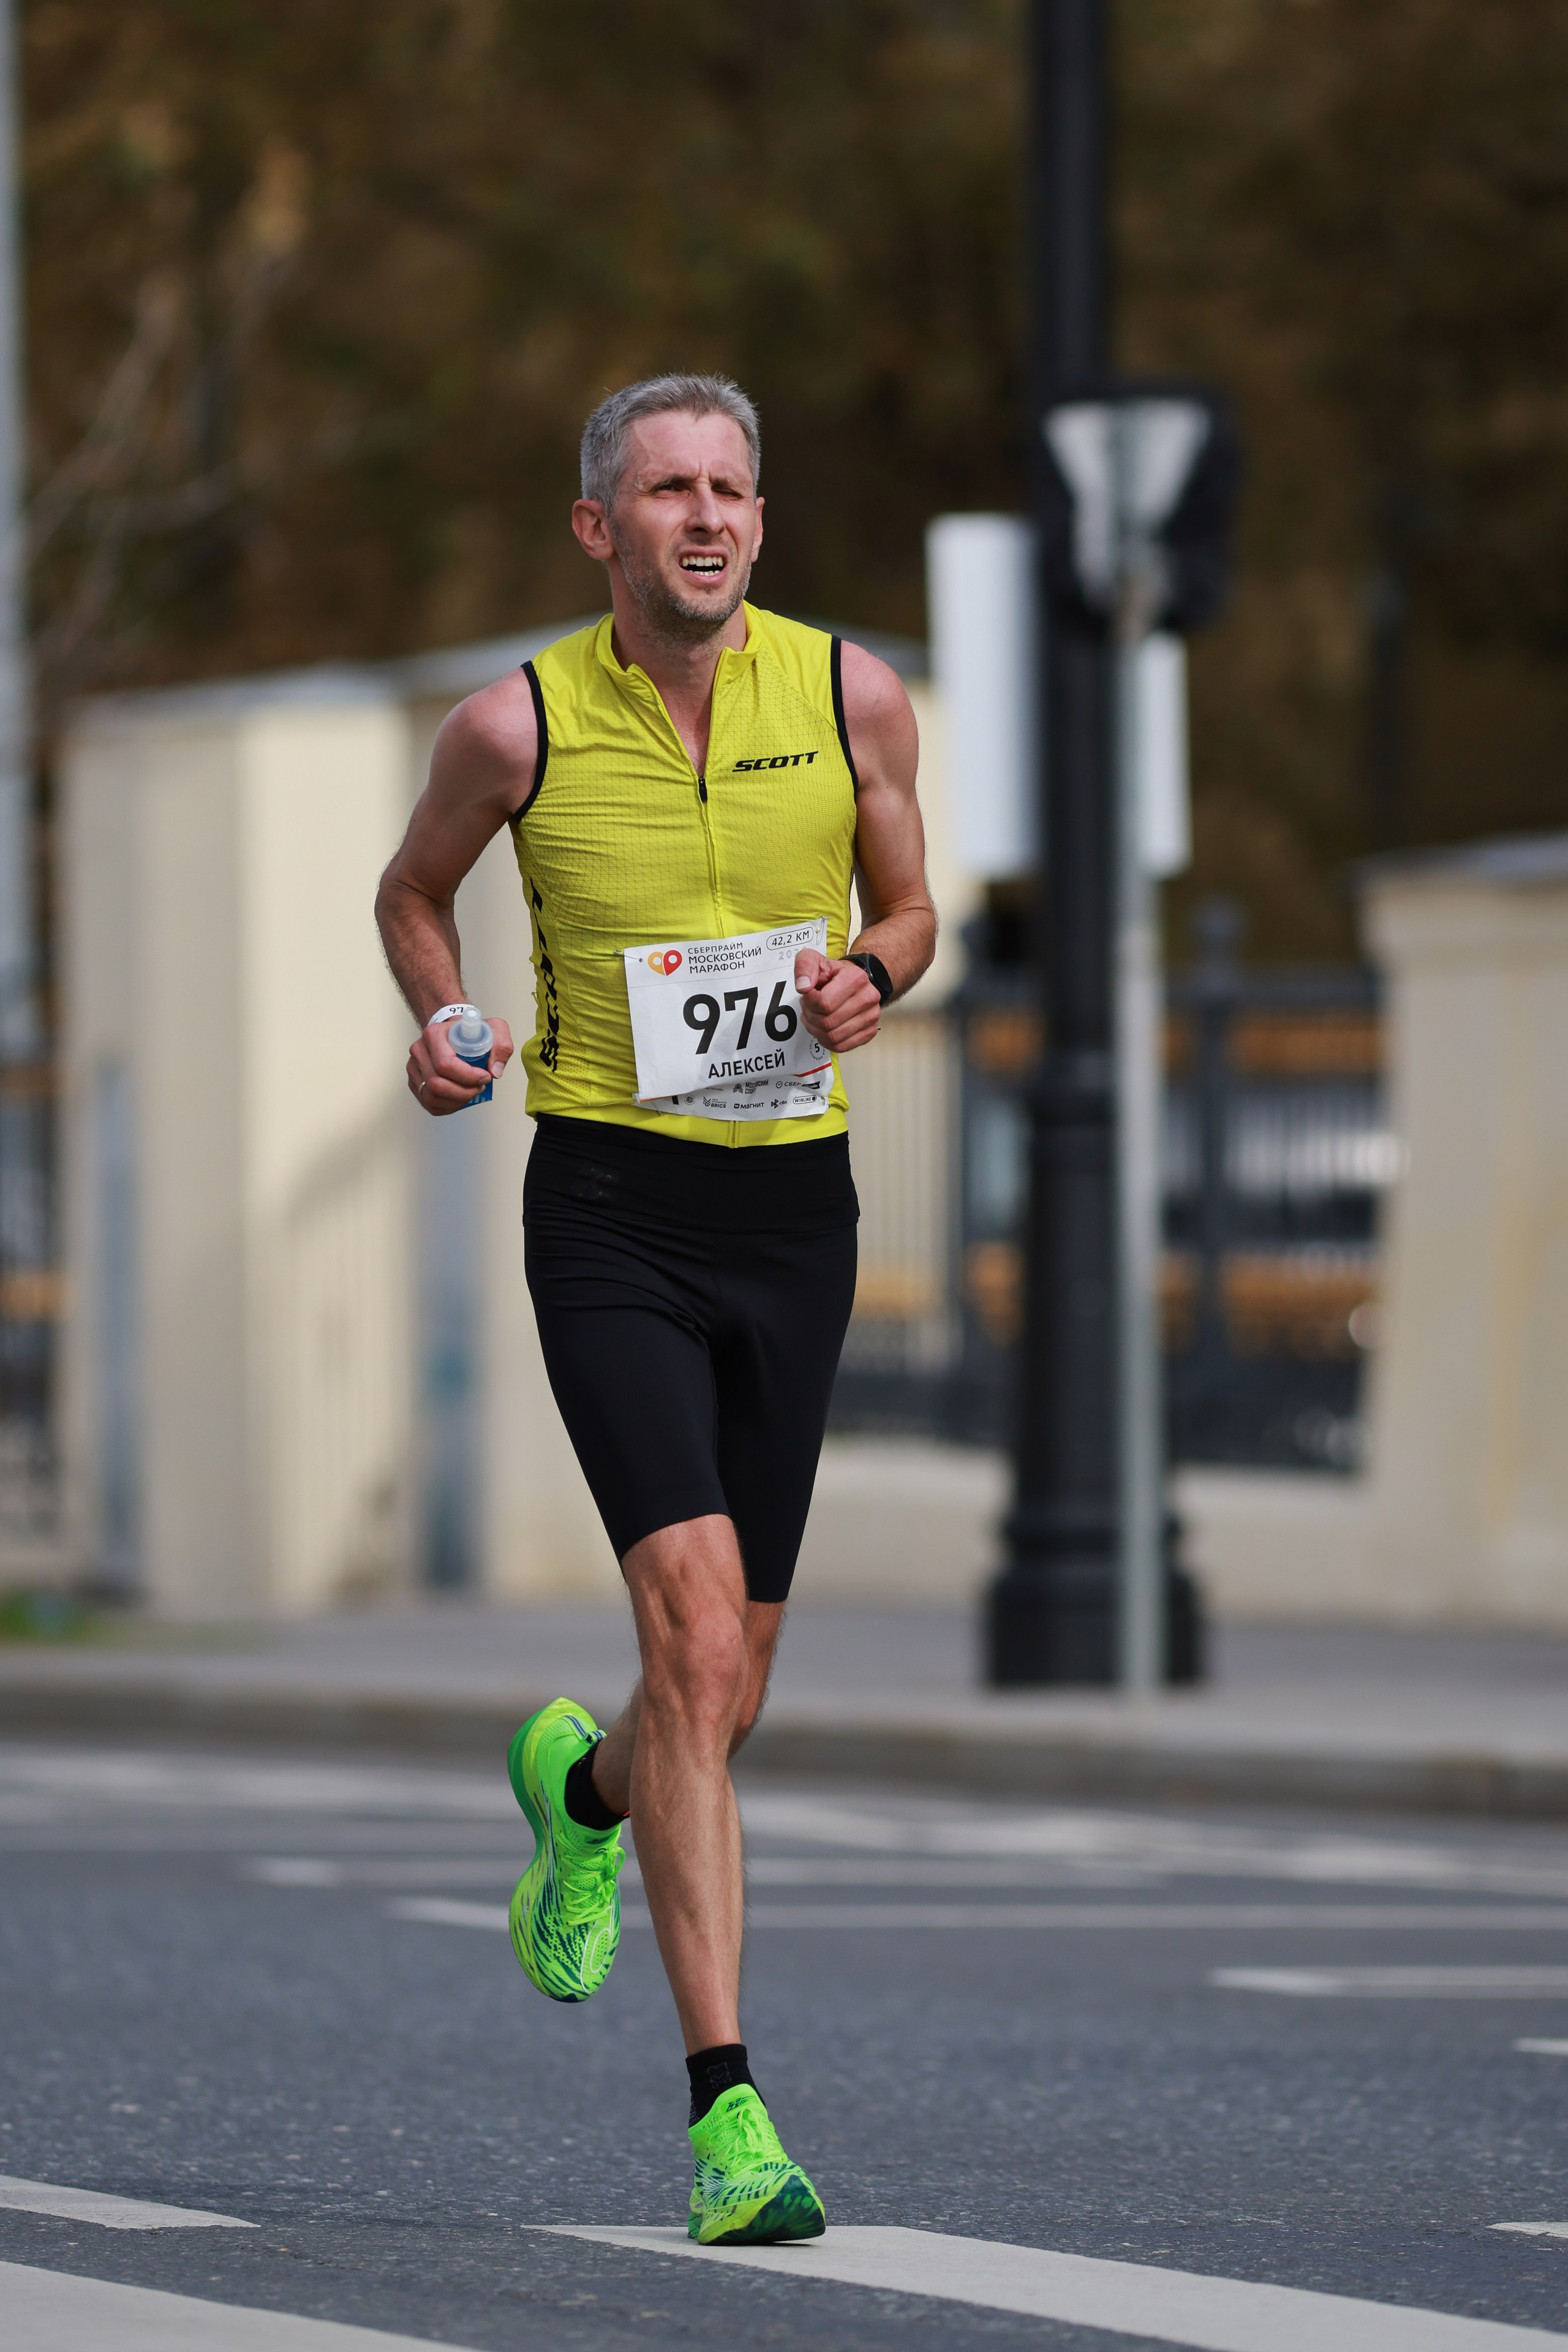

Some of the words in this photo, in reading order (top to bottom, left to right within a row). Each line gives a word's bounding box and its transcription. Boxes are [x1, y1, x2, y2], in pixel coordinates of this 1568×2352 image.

[732, 751, 818, 772] SCOTT
[772, 935, 792, 946] 42,2
[796, 930, 809, 941] КМ
[687, 942, 744, 954] СБЕРПРАЙМ
[688, 946, 762, 965] МОСКОВСКИЙ
[778, 946, 807, 960] 202
[689, 960, 745, 974] МАРАФОН
[682, 980, 797, 1055] 976
[814, 1042, 820, 1053] 5
[707, 1049, 786, 1079] АЛЕКСЕЙ
